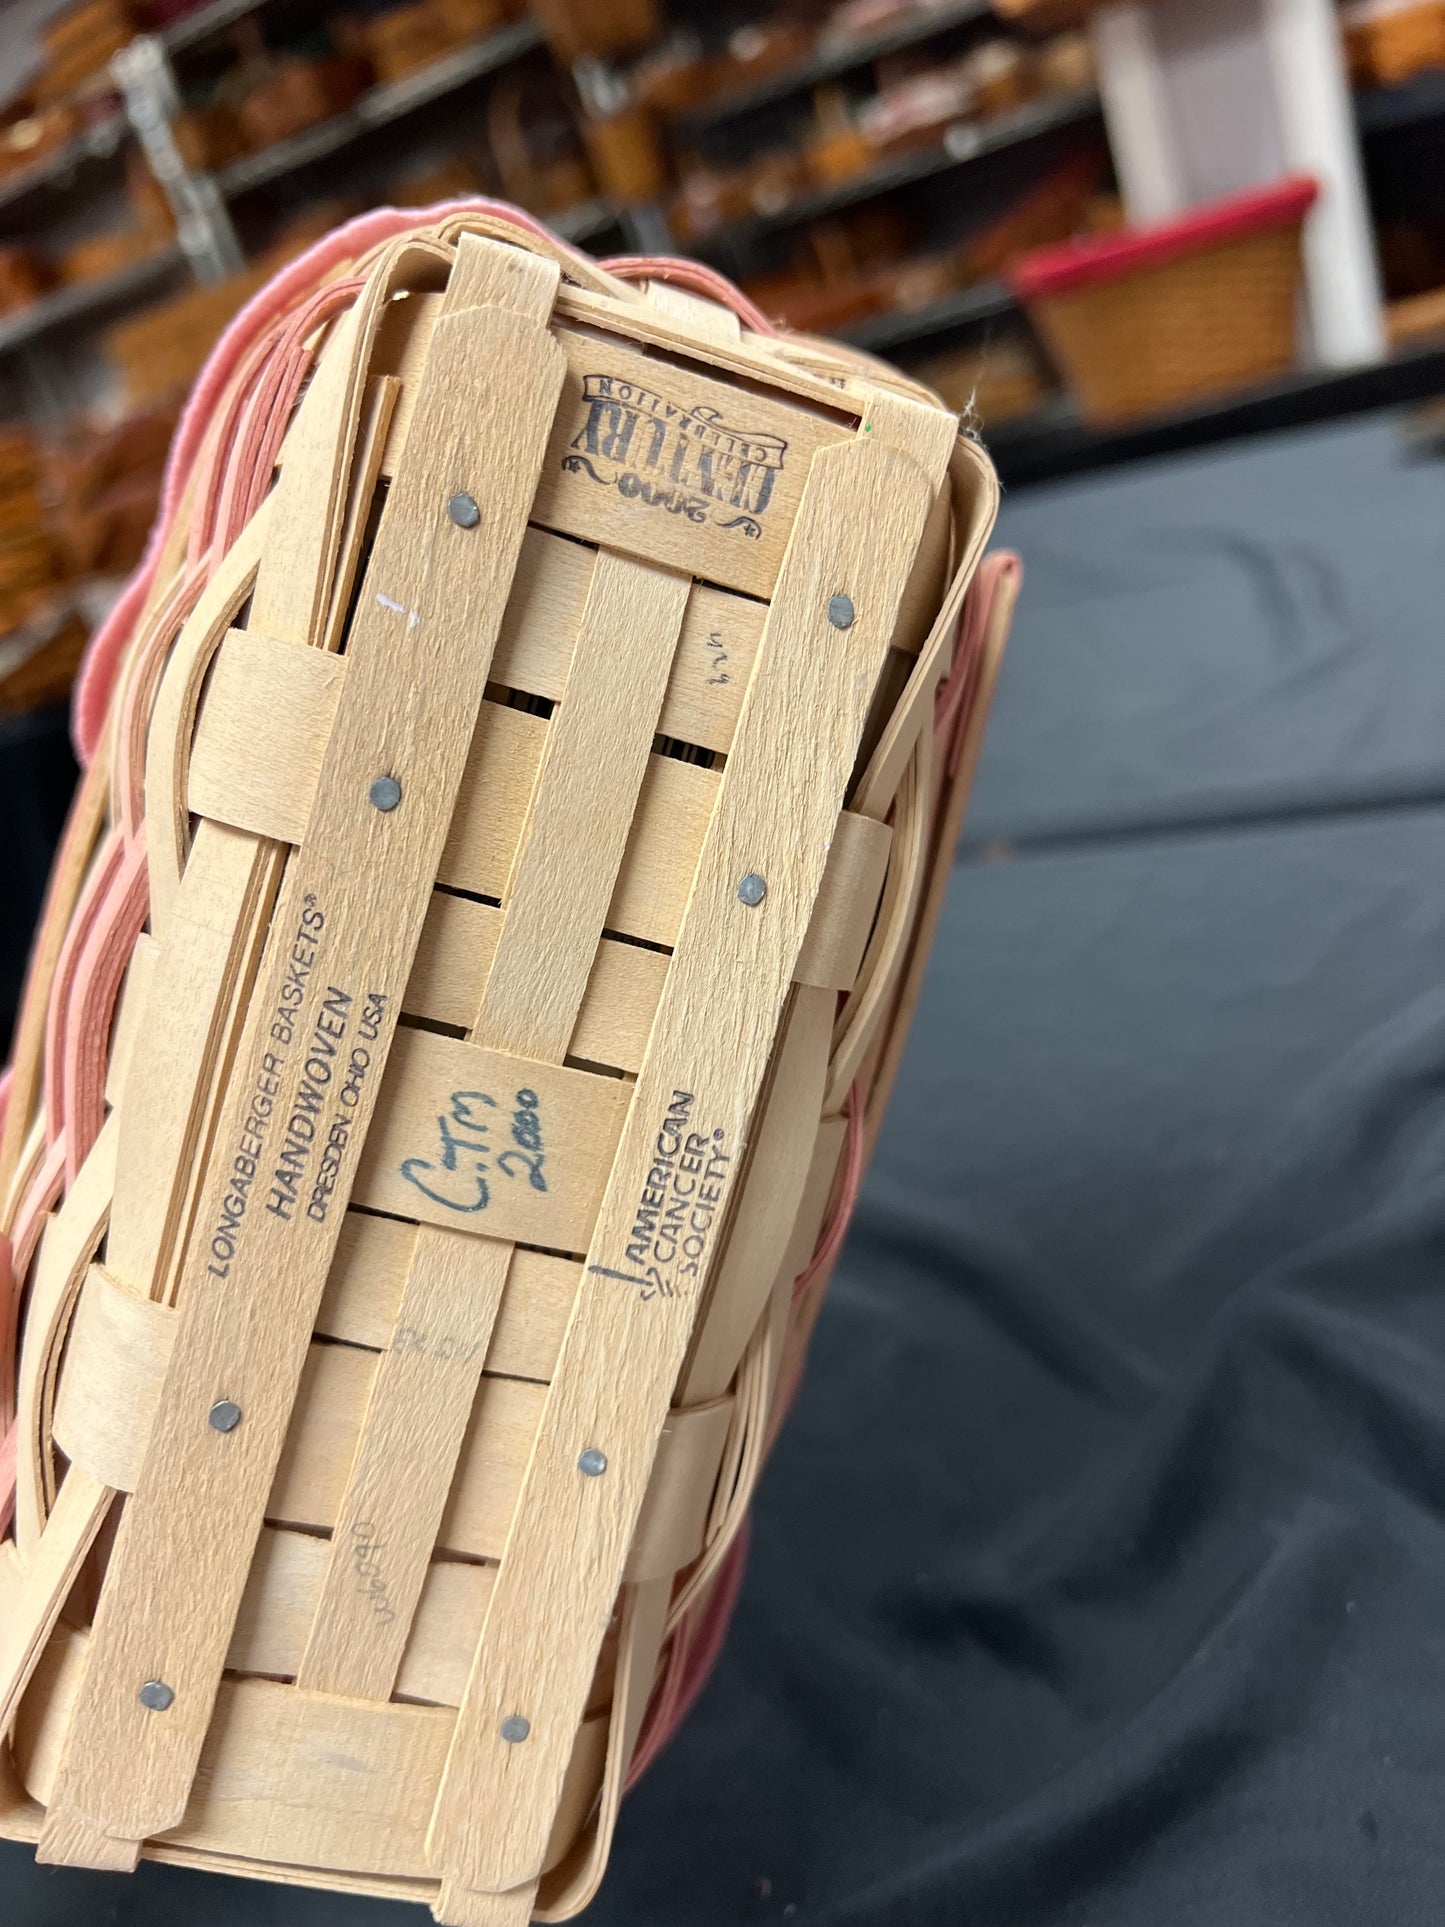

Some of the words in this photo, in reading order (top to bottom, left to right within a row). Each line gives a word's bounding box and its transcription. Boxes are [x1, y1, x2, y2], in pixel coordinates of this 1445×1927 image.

[599, 379, 768, 462] CELEBRATION
[207, 1052, 284, 1279] LONGABERGER
[265, 986, 353, 1221] HANDWOVEN
[306, 1114, 353, 1224] DRESDEN
[340, 1048, 371, 1108] OHIO
[358, 993, 387, 1042] USA
[626, 1089, 695, 1266] AMERICAN
[653, 1132, 710, 1264] CANCER
